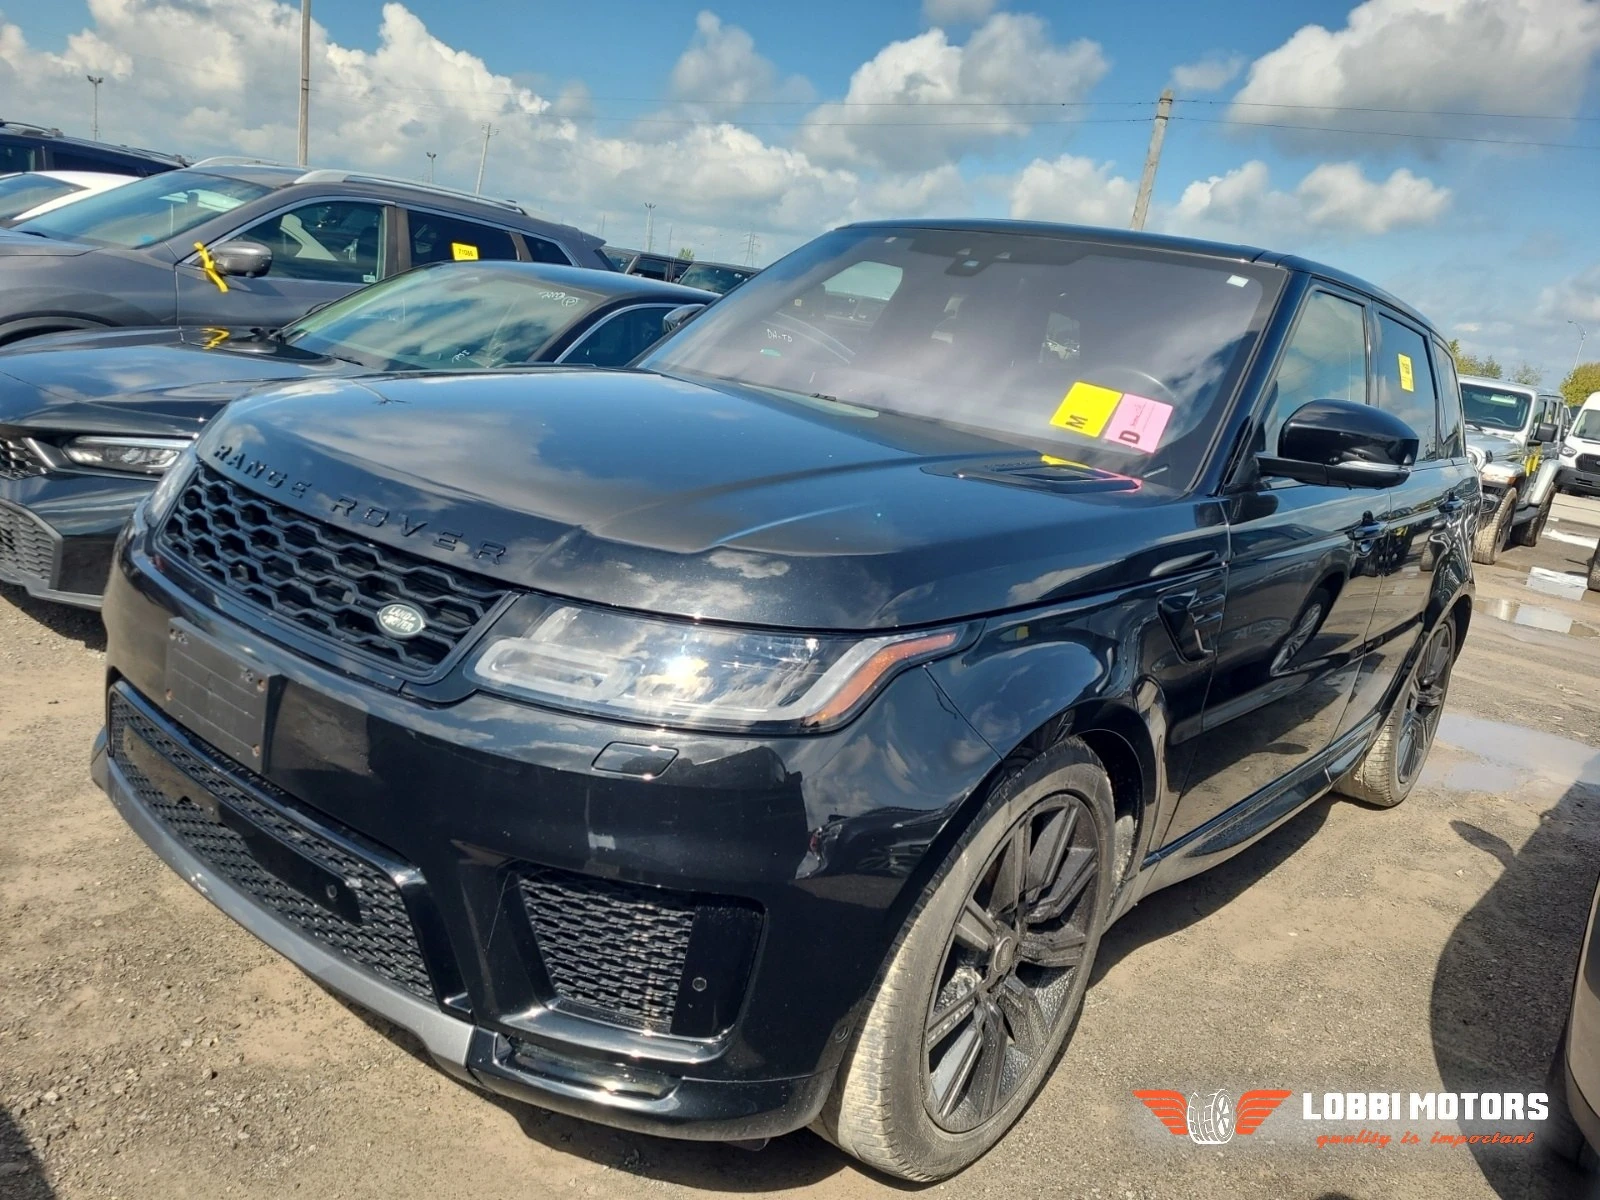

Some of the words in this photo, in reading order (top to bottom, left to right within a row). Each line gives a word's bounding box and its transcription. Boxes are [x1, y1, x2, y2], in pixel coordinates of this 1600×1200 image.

[1065, 414, 1089, 430] M
[1118, 430, 1141, 445] D
[213, 446, 312, 499] RANGE
[331, 495, 507, 566] ROVER
[388, 607, 412, 620] LAND
[385, 615, 414, 632] ROVER
